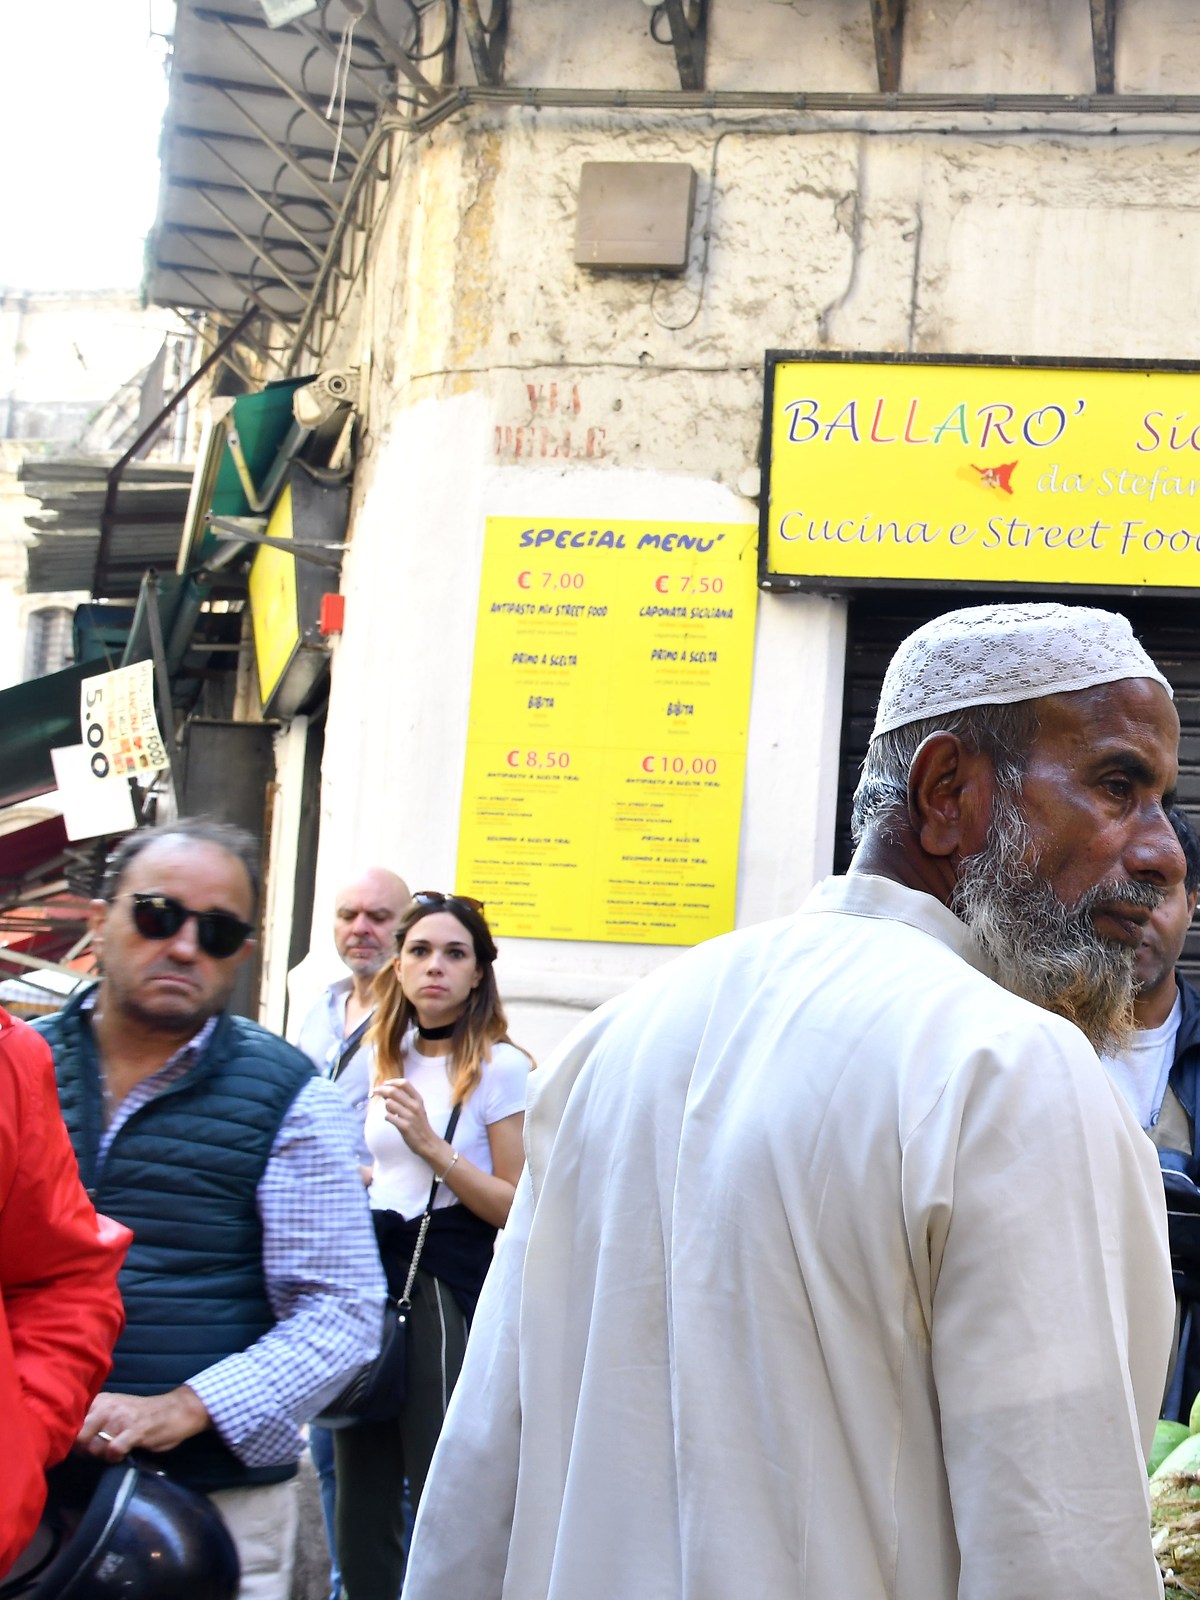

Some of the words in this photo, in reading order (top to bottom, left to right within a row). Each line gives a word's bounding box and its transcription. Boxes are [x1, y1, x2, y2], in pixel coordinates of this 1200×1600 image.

[1037, 464, 1093, 493] da
[519, 529, 626, 549] SPECIAL
[780, 511, 941, 544] Cucina
[950, 522, 978, 546] e
[982, 516, 1111, 549] Street
[517, 571, 531, 589] €
[542, 573, 585, 590] 7,00
[655, 575, 669, 593] €
[680, 577, 724, 595] 7,50
[556, 605, 585, 617] STREET
[587, 606, 608, 618] FOOD
[639, 606, 688, 617] CAPONATA
[147, 735, 166, 766] FOOD
[507, 750, 520, 767] €
[526, 751, 571, 769] 8,50
[642, 756, 655, 773] €
[661, 757, 717, 775] 10,00
